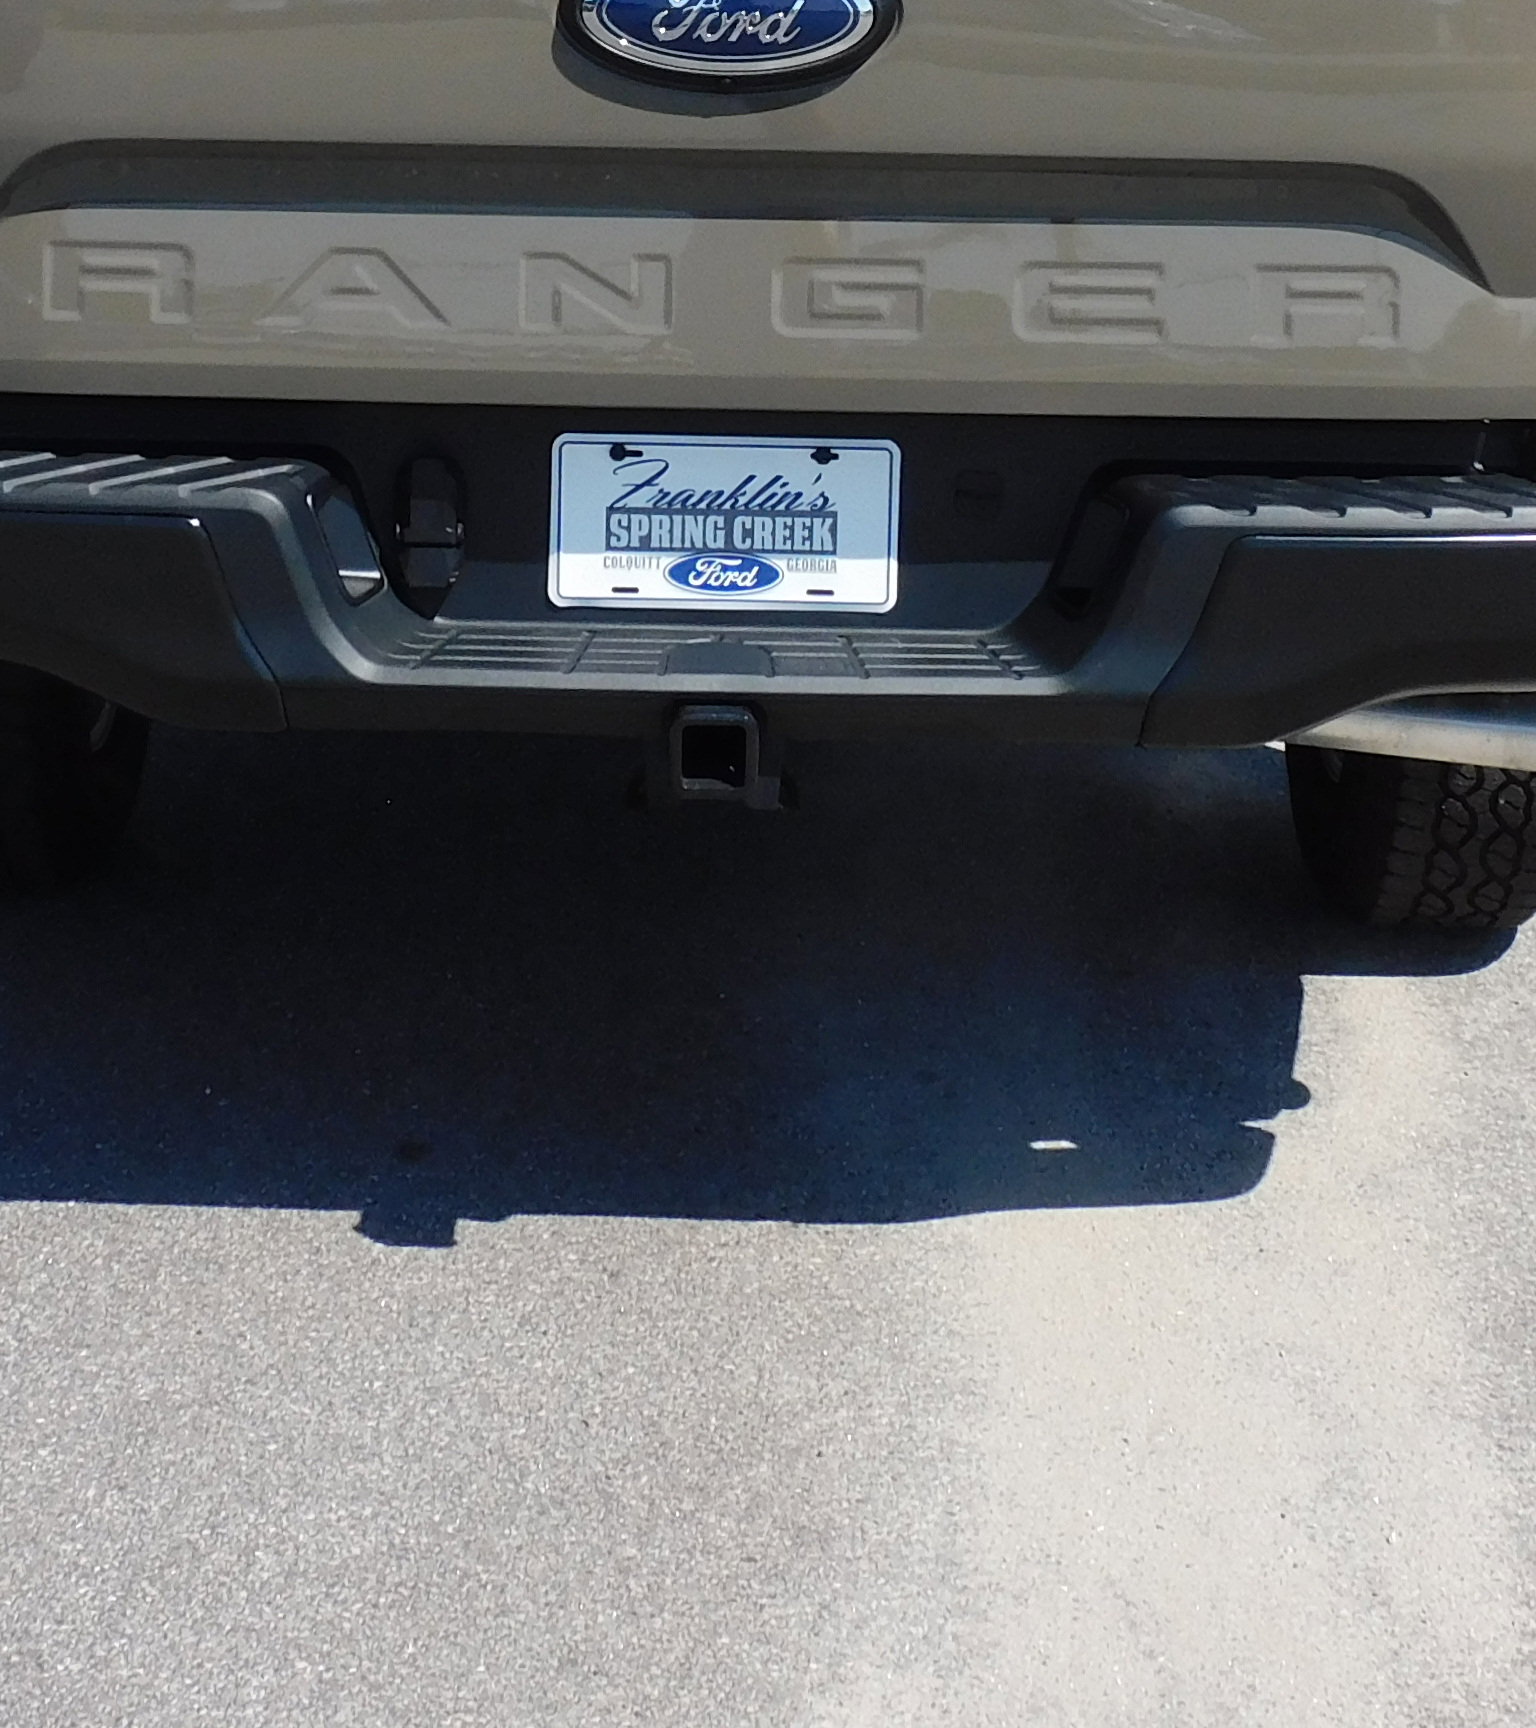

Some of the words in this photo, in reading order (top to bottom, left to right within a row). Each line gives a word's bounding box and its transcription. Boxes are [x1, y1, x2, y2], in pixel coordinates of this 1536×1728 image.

[42, 239, 1401, 348] RANGER
[609, 458, 836, 512] Franklin's
[609, 512, 726, 550] SPRING
[732, 514, 835, 552] CREEK
[603, 555, 662, 571] COLQUITT
[786, 557, 838, 573] GEORGIA
[688, 556, 759, 588] Ford
